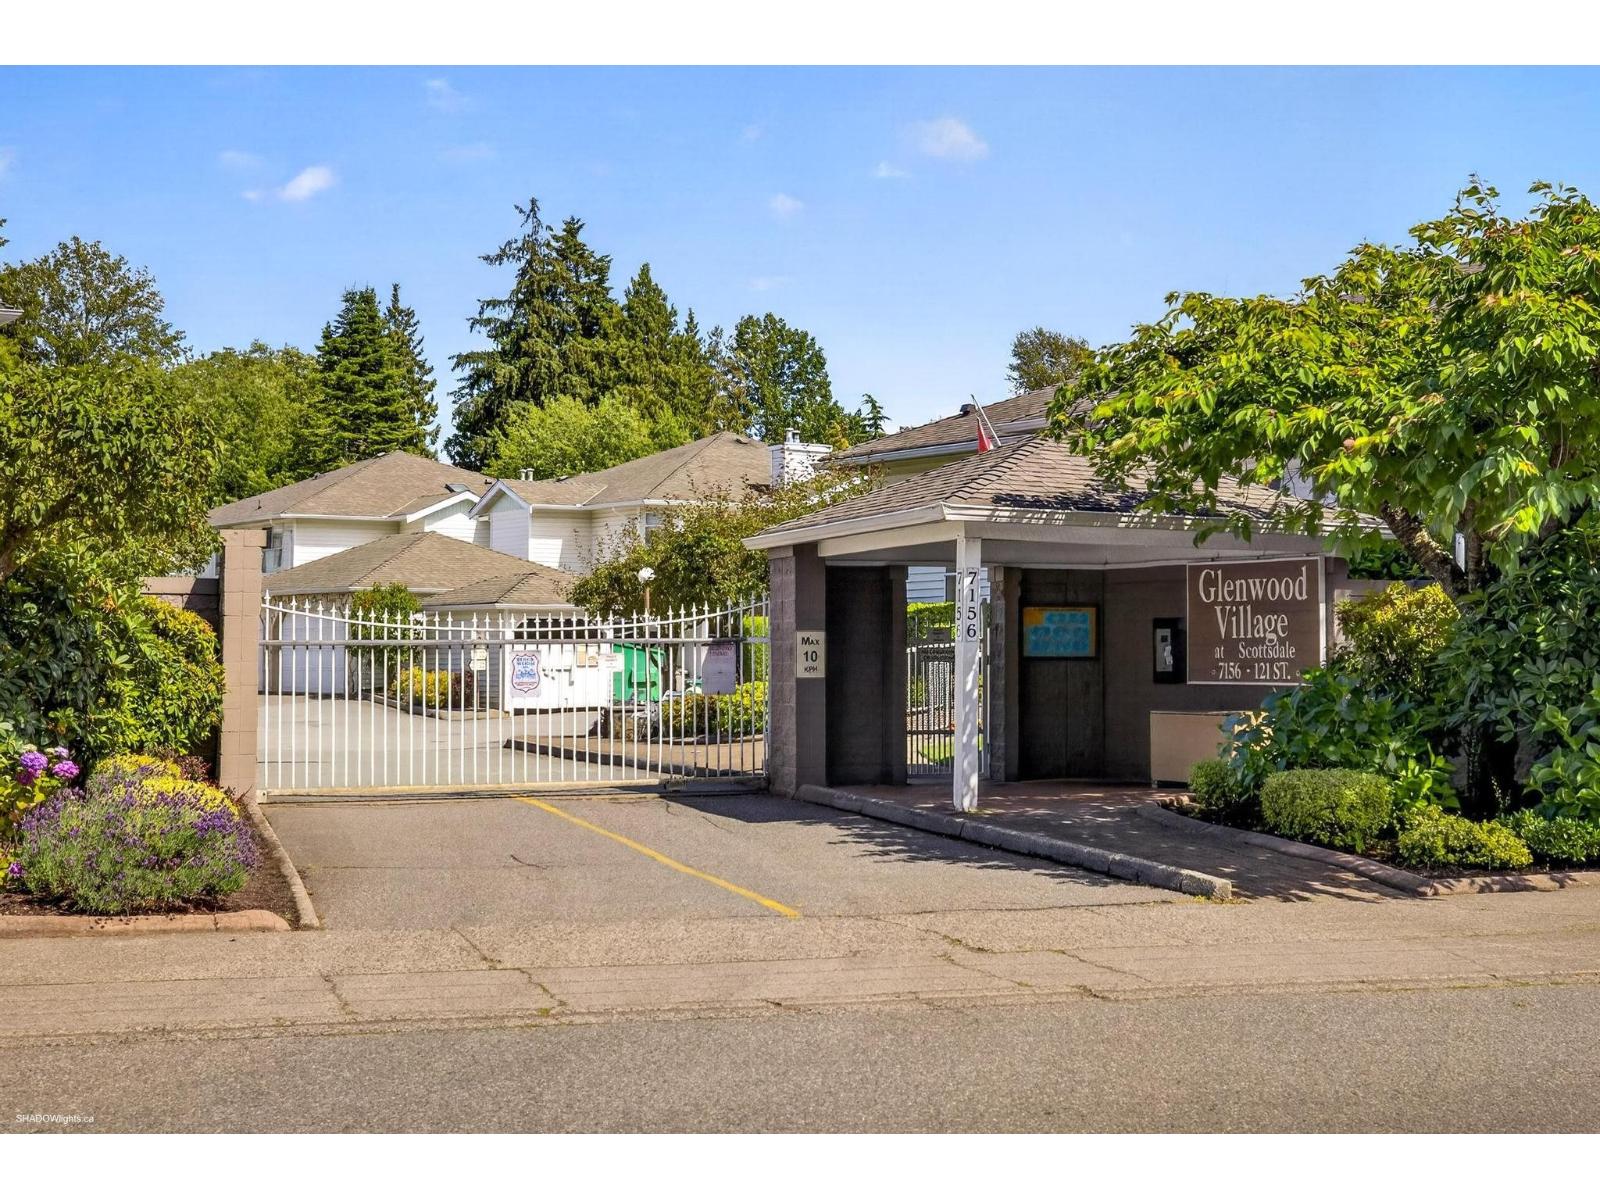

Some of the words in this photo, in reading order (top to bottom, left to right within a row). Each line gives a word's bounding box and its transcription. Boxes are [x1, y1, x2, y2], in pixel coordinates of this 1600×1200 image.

[1199, 565, 1308, 603] Glenwood
[966, 571, 978, 638] 7156
[1214, 604, 1289, 646] Village
[803, 650, 818, 662] 10
[1214, 645, 1225, 659] at
[1238, 641, 1296, 659] Scottsdale
[1218, 662, 1242, 680] 7156
